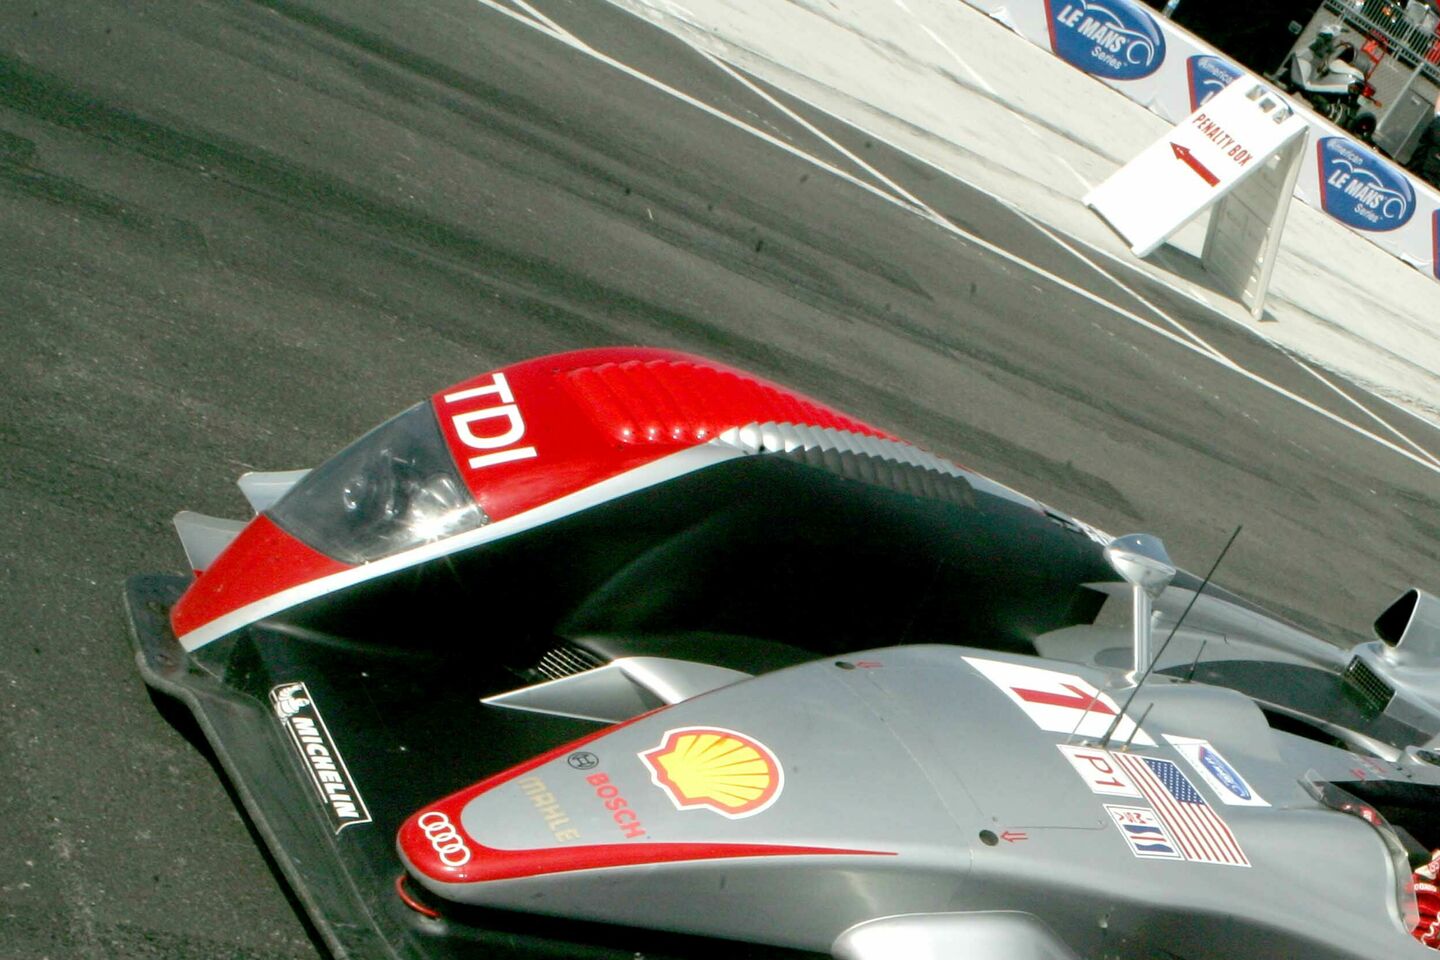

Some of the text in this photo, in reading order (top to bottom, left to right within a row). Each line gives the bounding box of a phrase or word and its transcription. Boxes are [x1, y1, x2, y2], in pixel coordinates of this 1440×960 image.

[1057, 5, 1126, 53] LE MANS
[1091, 46, 1122, 70] Series
[1198, 56, 1233, 83] America
[1193, 114, 1253, 167] PENALTY BOX
[1327, 139, 1363, 165] American
[1328, 169, 1384, 208] LE MANS
[1354, 203, 1380, 223] Series
[444, 372, 538, 469] TDI
[1009, 683, 1117, 716] 1
[292, 717, 359, 818] MICHELIN
[1074, 754, 1126, 787] P1
[516, 776, 581, 842] MAHLE
[585, 772, 646, 839] BOSCH
